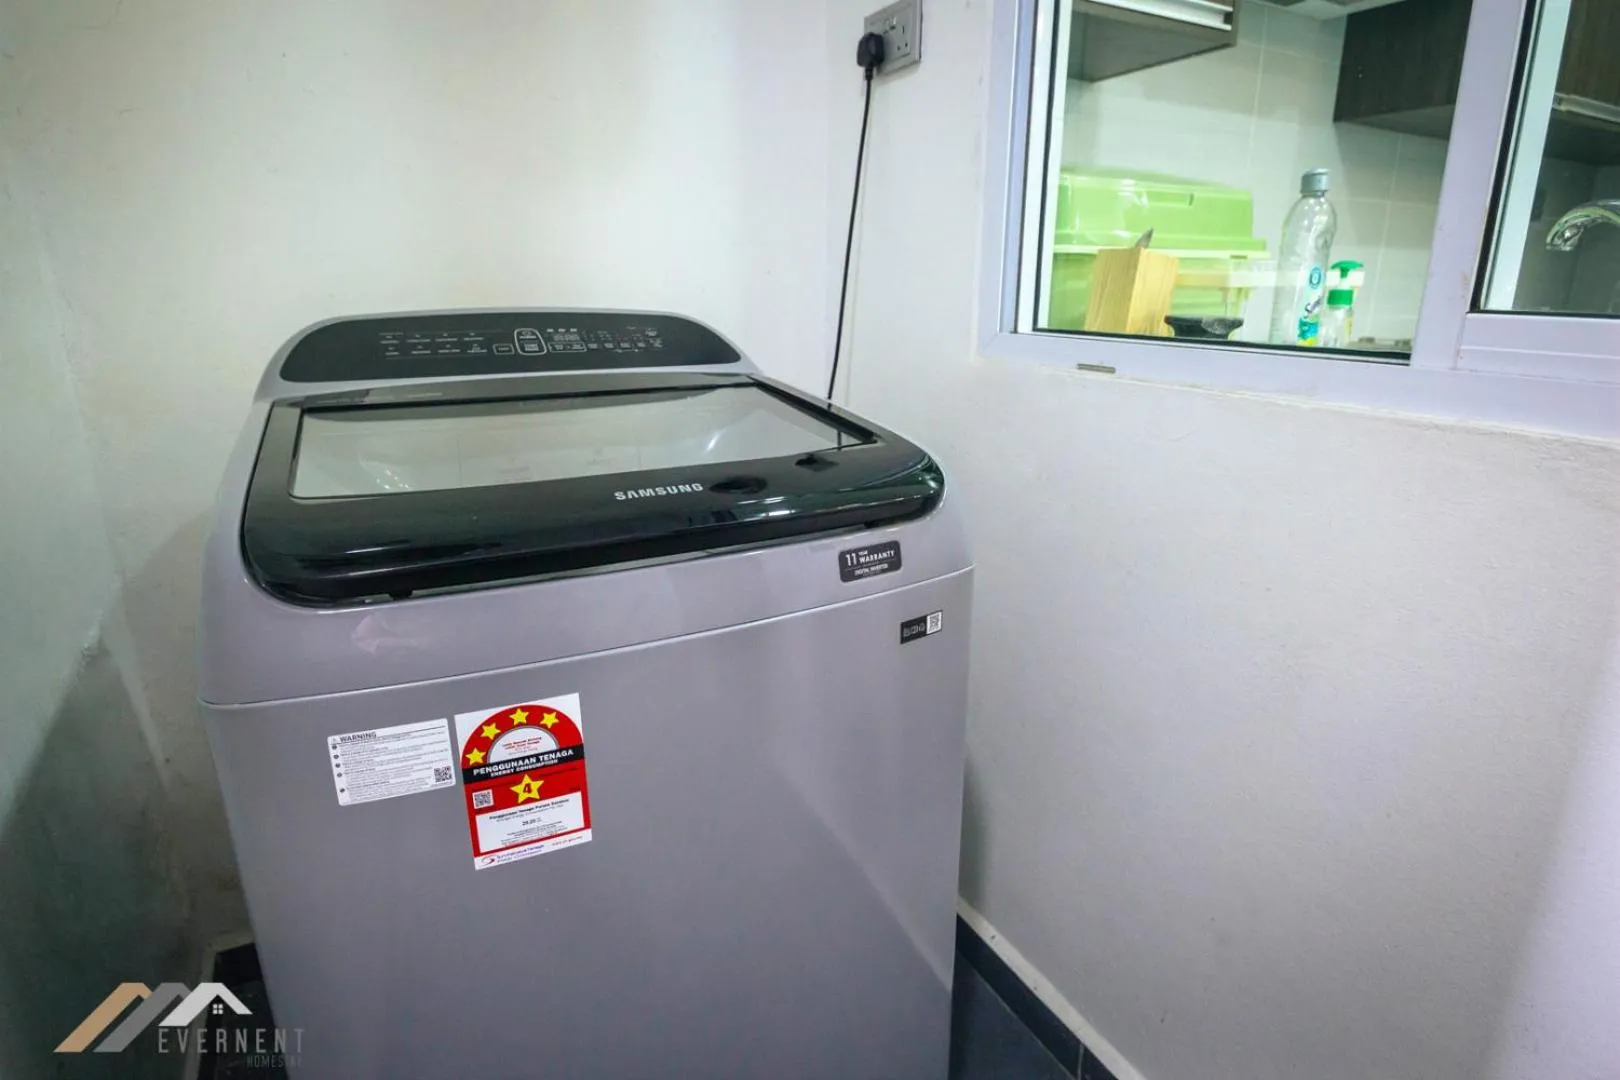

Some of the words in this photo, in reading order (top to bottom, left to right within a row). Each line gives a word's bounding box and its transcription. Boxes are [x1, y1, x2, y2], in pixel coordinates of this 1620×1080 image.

[613, 483, 704, 500] SAMSUNG
[845, 552, 857, 567] 11
[859, 550, 895, 564] WARRANTY
[340, 731, 378, 743] WARNING
[473, 757, 536, 776] PENGGUNAAN
[538, 749, 574, 761] TENAGA
[490, 768, 514, 777] ENERGY
[516, 759, 558, 772] CONSUMPTION
[523, 783, 532, 794] 4
